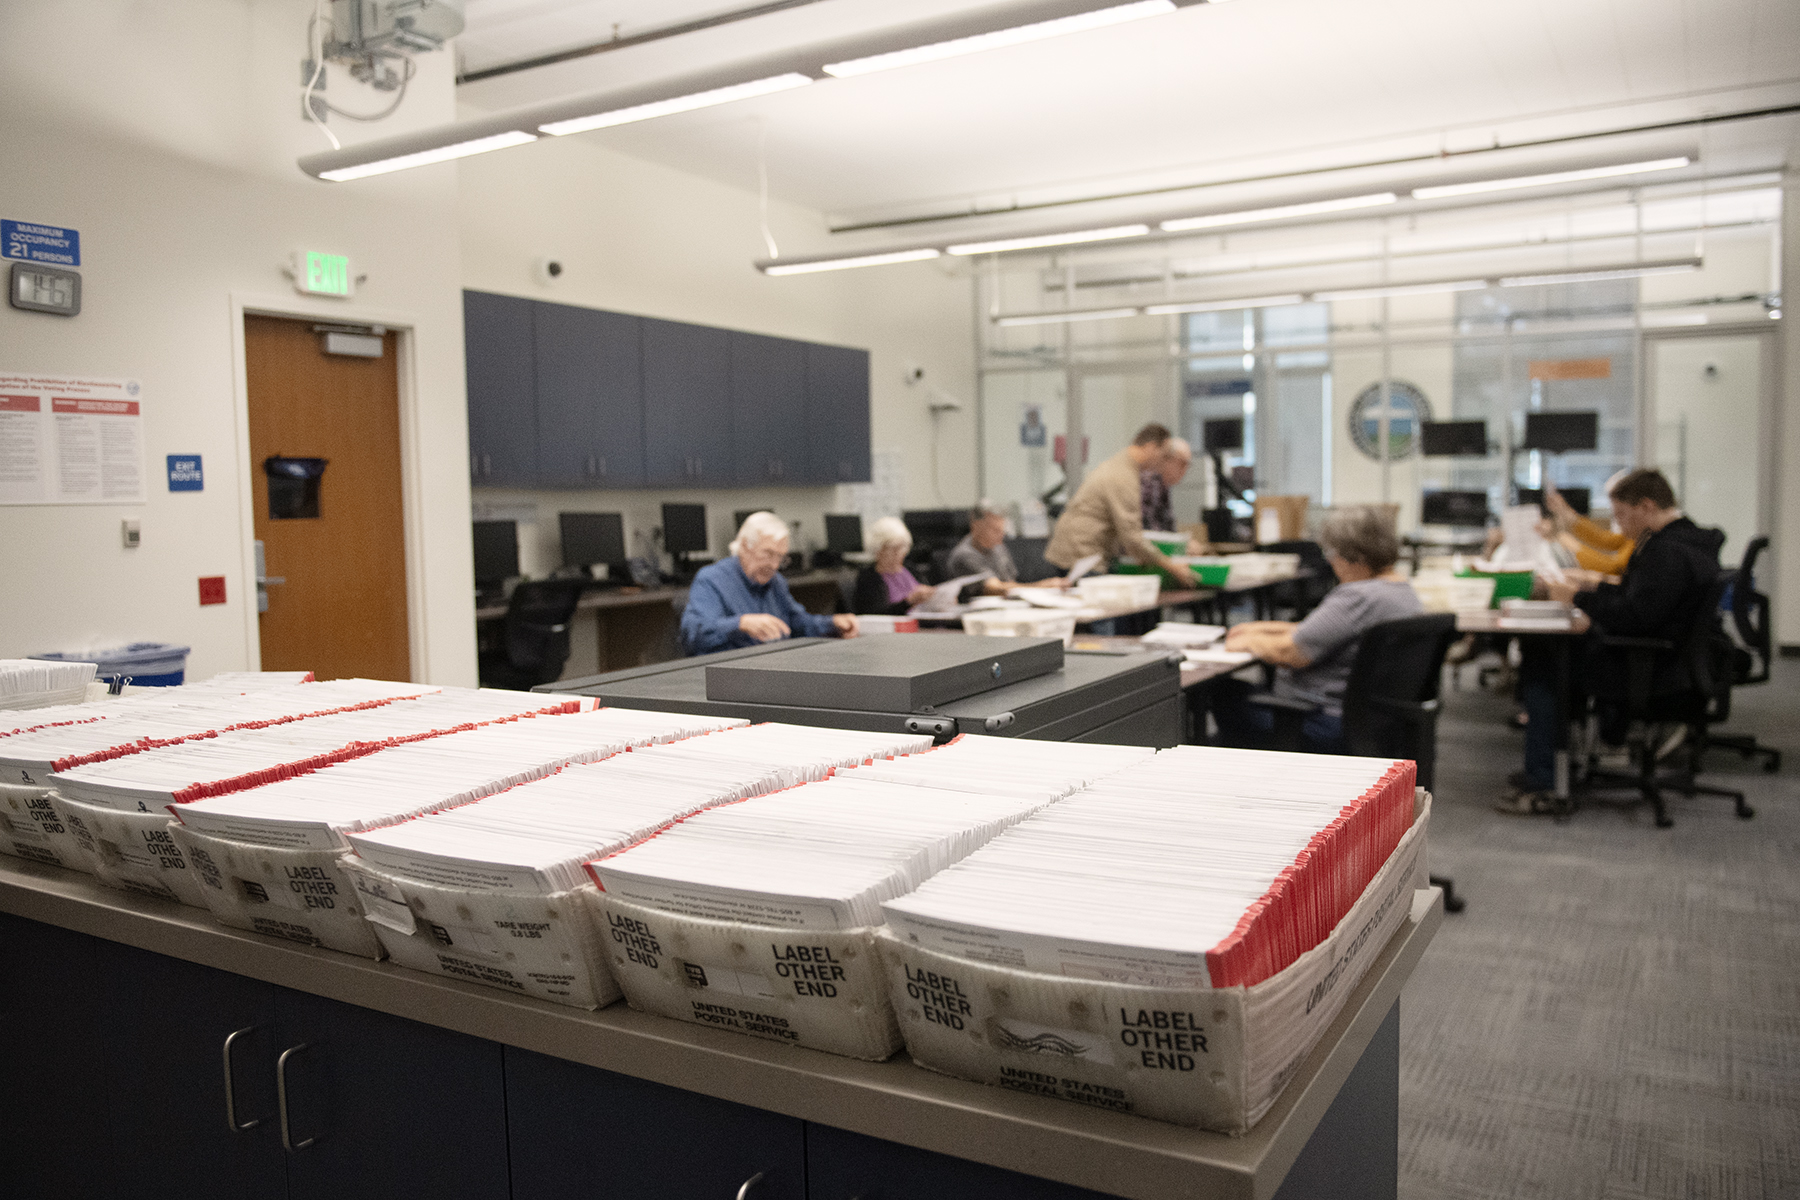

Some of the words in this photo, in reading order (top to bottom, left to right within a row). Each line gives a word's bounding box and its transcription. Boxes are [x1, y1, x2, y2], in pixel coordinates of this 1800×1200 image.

[10, 232, 70, 248] OCCUPANCY
[16, 224, 64, 238] MAXIMUM
[9, 241, 28, 258] 21
[32, 251, 74, 264] PERSONS
[306, 251, 349, 295] EXIT
[170, 470, 201, 481] ROUTE
[175, 460, 195, 471] EXIT
[24, 798, 53, 810] LABE
[30, 811, 62, 822] OTHE
[42, 823, 65, 834] END
[141, 829, 173, 844] LABE
[160, 856, 186, 870] END
[283, 865, 331, 880] LABEL
[290, 880, 338, 895] OTHER
[304, 895, 336, 909] END
[494, 921, 517, 930] TARE
[517, 922, 551, 931] WEIGHT
[524, 930, 542, 939] LBS
[606, 911, 656, 940] LABEL
[612, 928, 663, 956] OTHER
[626, 947, 658, 969] END
[772, 944, 839, 964] LABEL
[436, 954, 473, 969] UNITED
[474, 963, 513, 979] STATES
[441, 963, 481, 979] POSTAL
[481, 973, 525, 990] SERVICE
[775, 962, 847, 982] OTHER
[794, 980, 838, 998] END
[905, 963, 967, 998] LABEL
[907, 982, 973, 1018] OTHER
[691, 1001, 737, 1017] UNITED
[738, 1010, 790, 1028] STATES
[923, 1004, 965, 1031] END
[1121, 1007, 1204, 1032] LABEL
[694, 1011, 744, 1029] POSTAL
[745, 1022, 800, 1041] SERVICE
[1121, 1029, 1209, 1053] OTHER
[1141, 1051, 1195, 1072] END
[1000, 1065, 1058, 1085] UNITED
[1060, 1078, 1125, 1099] STATES
[1000, 1077, 1058, 1096] POSTAL
[1063, 1090, 1136, 1112] SERVICE
